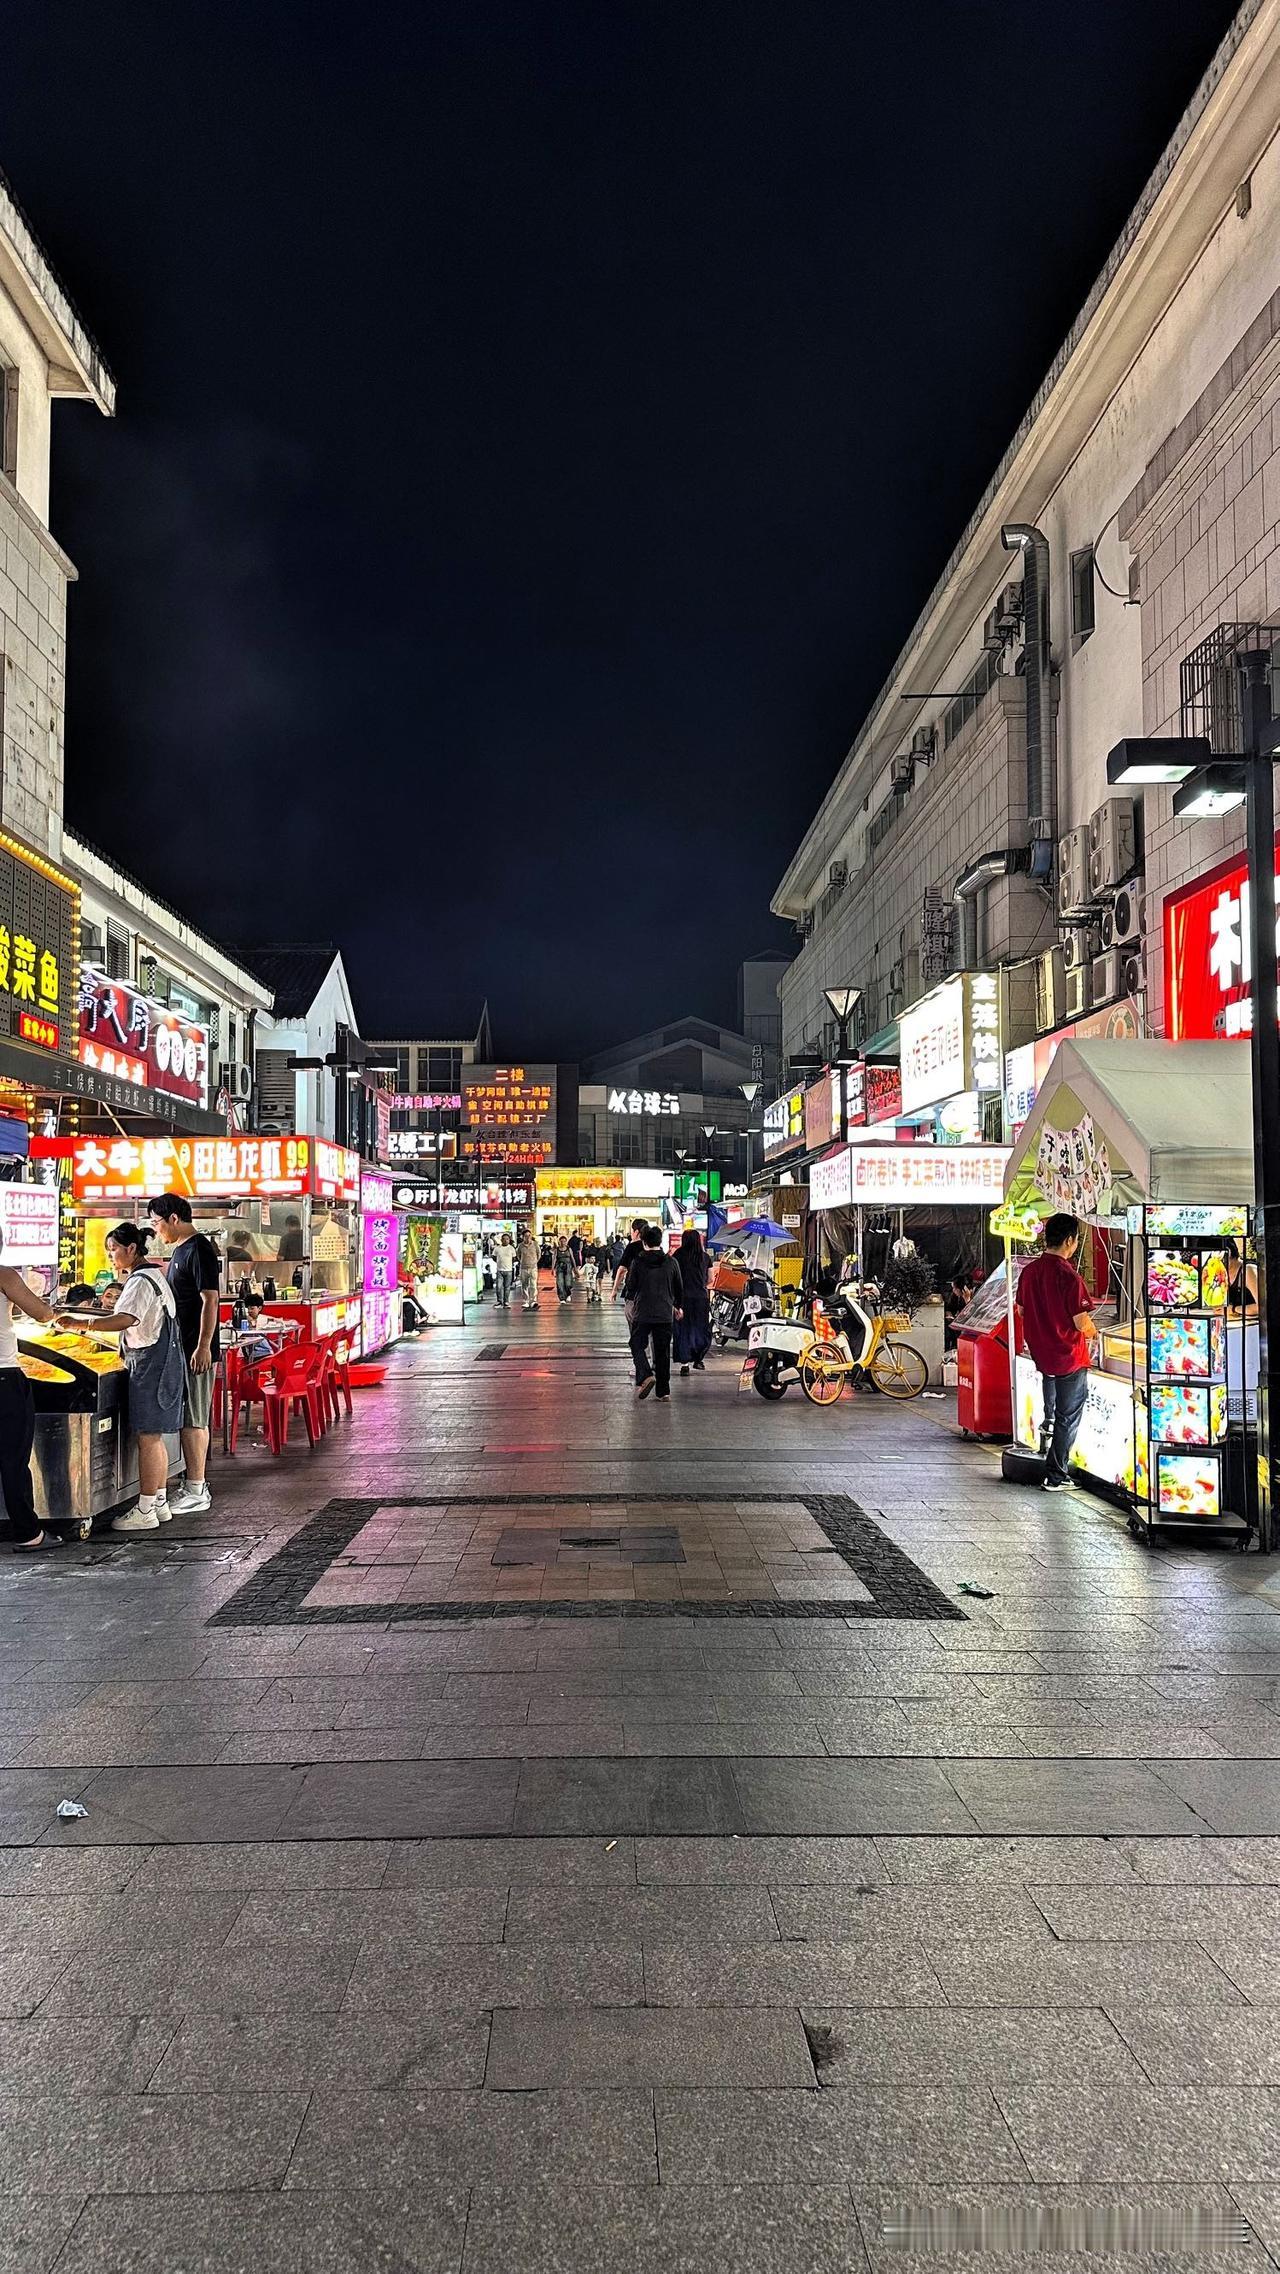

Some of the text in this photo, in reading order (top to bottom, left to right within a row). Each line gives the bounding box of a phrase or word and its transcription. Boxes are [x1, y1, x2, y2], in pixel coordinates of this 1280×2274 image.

[923, 886, 945, 980] 昌隆棋牌
[496, 1068, 525, 1082] 二楼
[193, 1140, 282, 1180] 盱眙龙虾
[286, 1139, 308, 1168] 99
[960, 1157, 1006, 1187] 铁板香豆
[724, 1183, 748, 1197] McD
